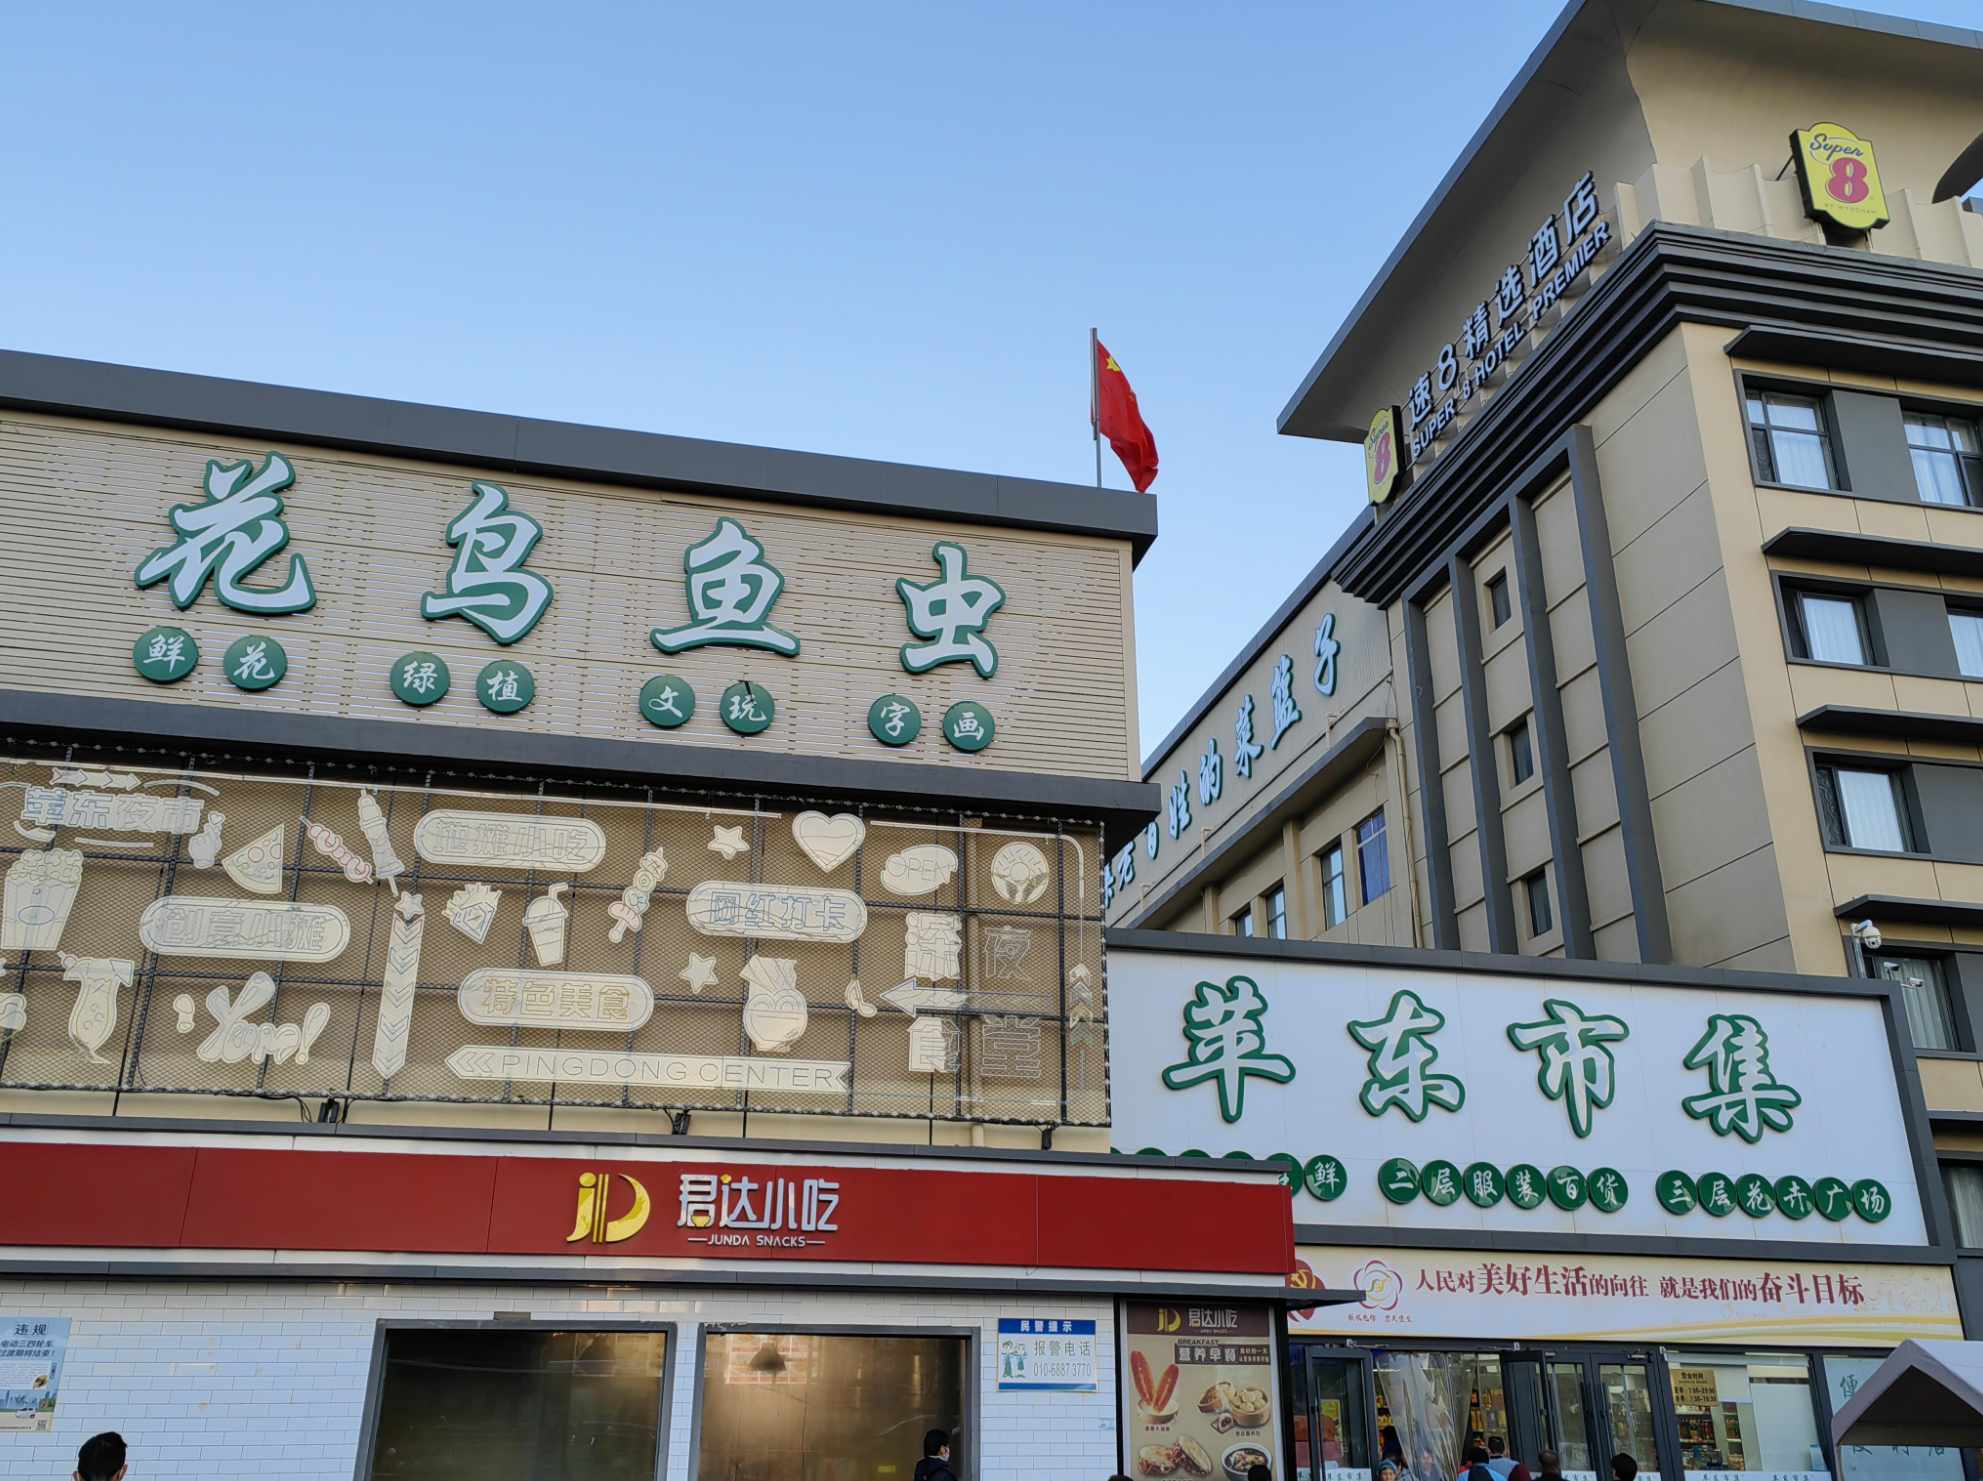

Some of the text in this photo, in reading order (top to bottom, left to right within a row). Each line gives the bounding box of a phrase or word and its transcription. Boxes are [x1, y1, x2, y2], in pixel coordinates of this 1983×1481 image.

[1809, 132, 1864, 162] Super
[1825, 156, 1870, 204] 8
[1838, 205, 1877, 215] WYNDHAM
[1408, 170, 1599, 432] 速8精选酒店
[1412, 219, 1613, 458] SUPER 8 HOTEL PREMIER
[1374, 431, 1392, 485] 8
[134, 450, 1006, 679] 花鸟鱼虫
[143, 634, 985, 740] 鲜花 绿植 文玩 字画
[20, 786, 206, 834] 苹东夜市
[433, 820, 588, 861] 地摊小吃
[885, 853, 958, 884] OPEN
[163, 905, 326, 951] 创意小摊
[711, 890, 848, 932] 网红打卡
[483, 978, 631, 1021] 特色美食
[907, 1014, 1042, 1079] 食堂
[1162, 975, 1802, 1144] 苹东市集
[500, 1053, 834, 1088] PINGDONG CENTER
[677, 1173, 840, 1231] 君达小吃
[1388, 1165, 1620, 1206] 二层服装百货
[1668, 1178, 1886, 1215] 三层花卉广场
[707, 1233, 806, 1248] JUNDA SNACKS
[1414, 1262, 1866, 1306] 人民对美好生活的向往 就是我们的奋斗目标
[14, 1323, 47, 1336] 违规
[1020, 1319, 1073, 1333] 民警提示
[1188, 1308, 1238, 1328] 君达小吃
[1, 1339, 54, 1348] 电动三四轮车
[1033, 1339, 1092, 1358] 报警电话
[1177, 1338, 1219, 1346] BREAKFAST
[1178, 1347, 1237, 1362] 营养早餐
[1033, 1362, 1092, 1378] 010-6887 3770
